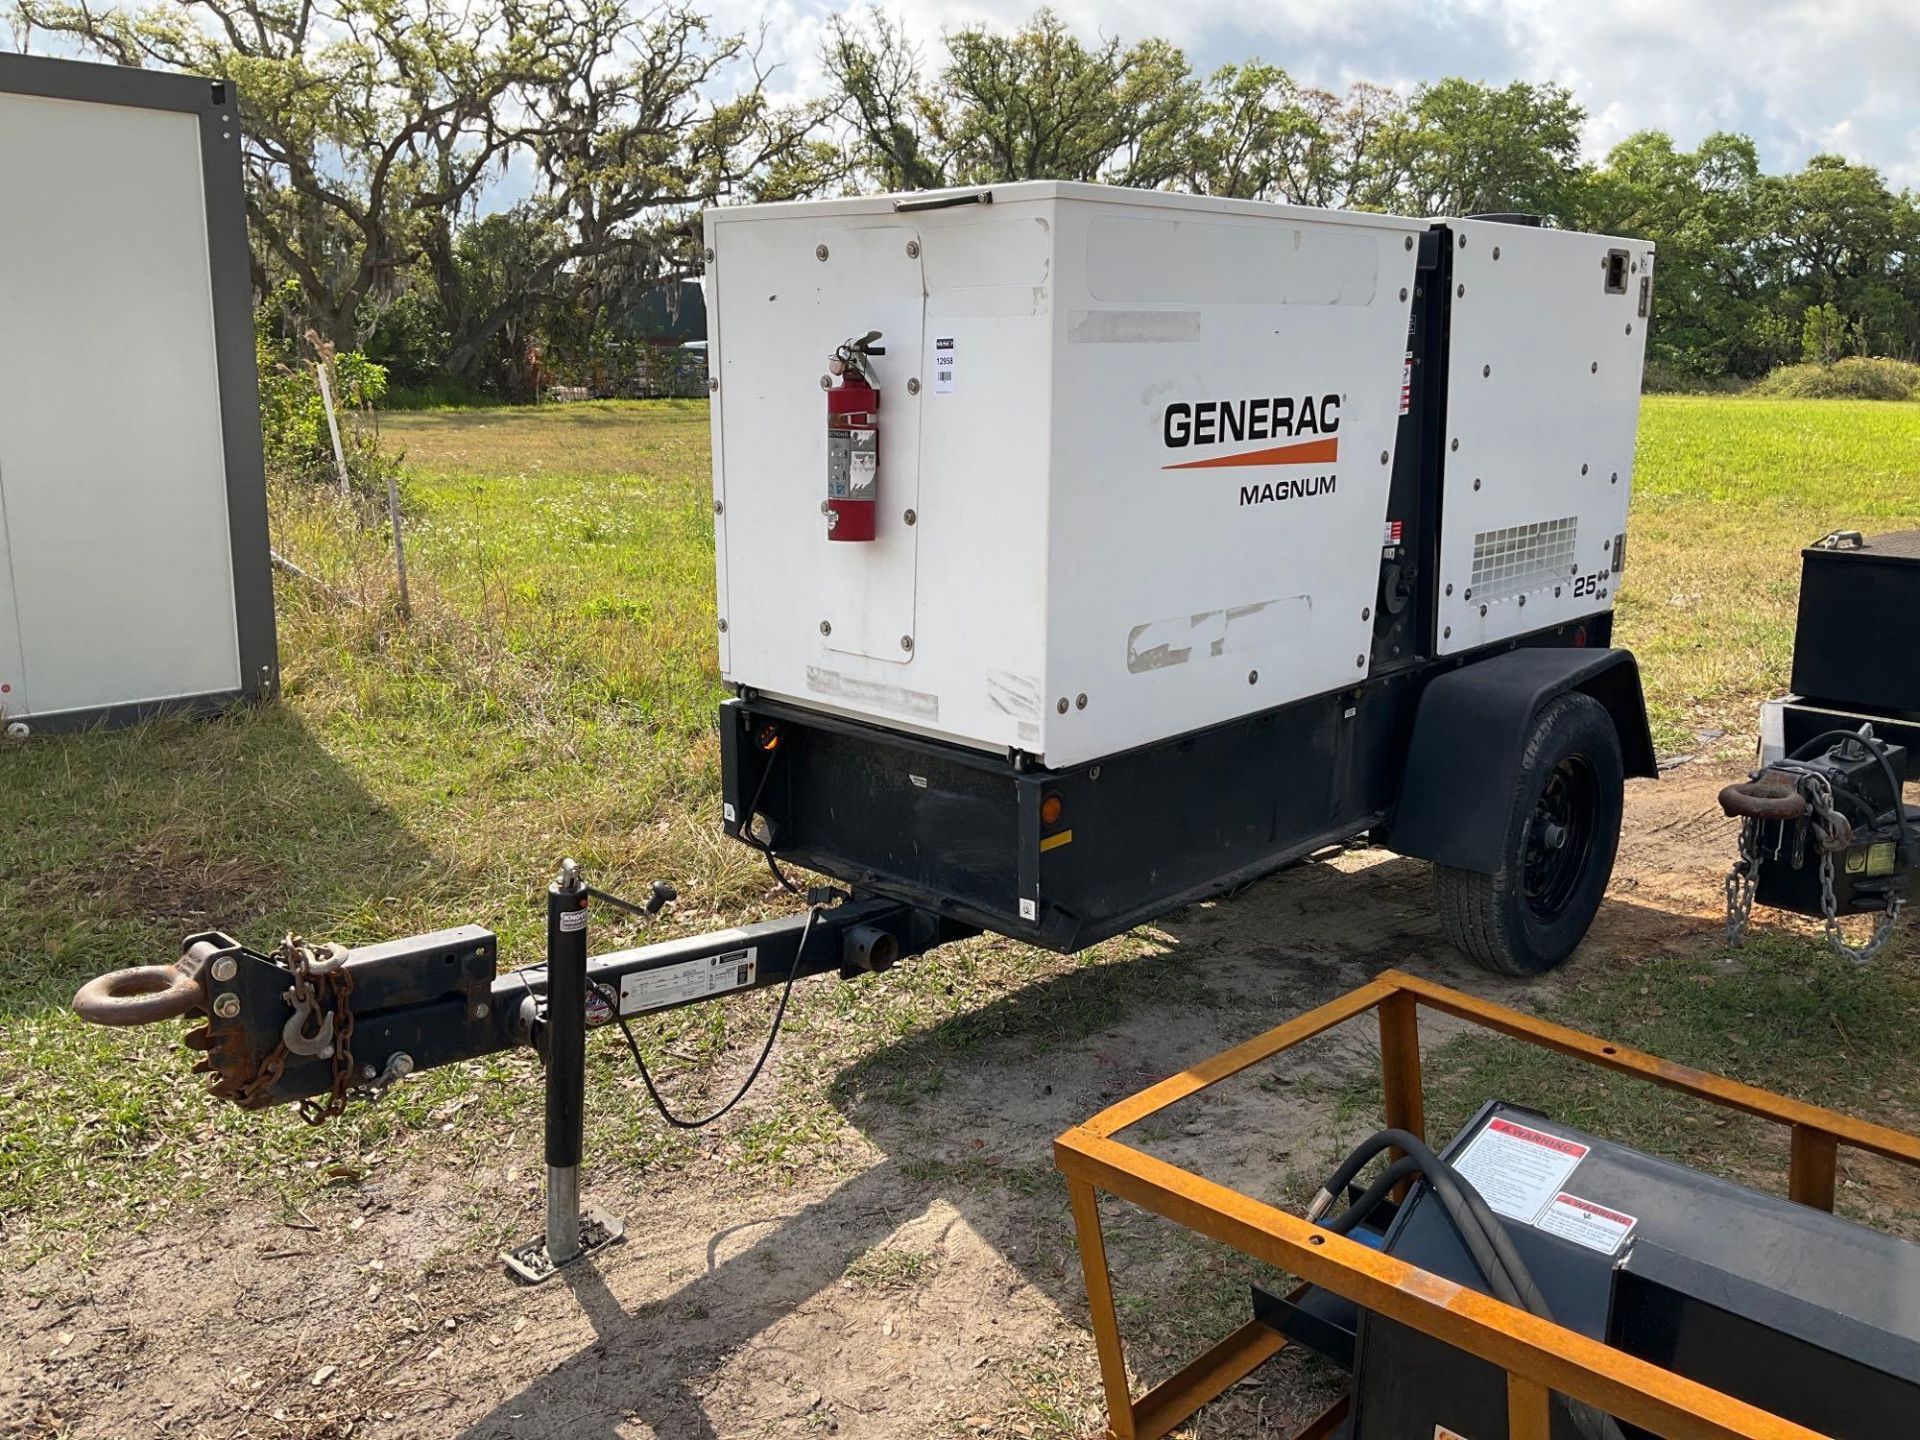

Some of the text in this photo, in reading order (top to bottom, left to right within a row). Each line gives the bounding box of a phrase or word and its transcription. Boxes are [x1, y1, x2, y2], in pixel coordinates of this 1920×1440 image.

[1163, 393, 1341, 448] GENERAC
[1239, 475, 1337, 506] MAGNUM
[1573, 574, 1597, 598] 25
[1513, 1129, 1573, 1152] WARNING
[1575, 1201, 1630, 1225] WARNING
